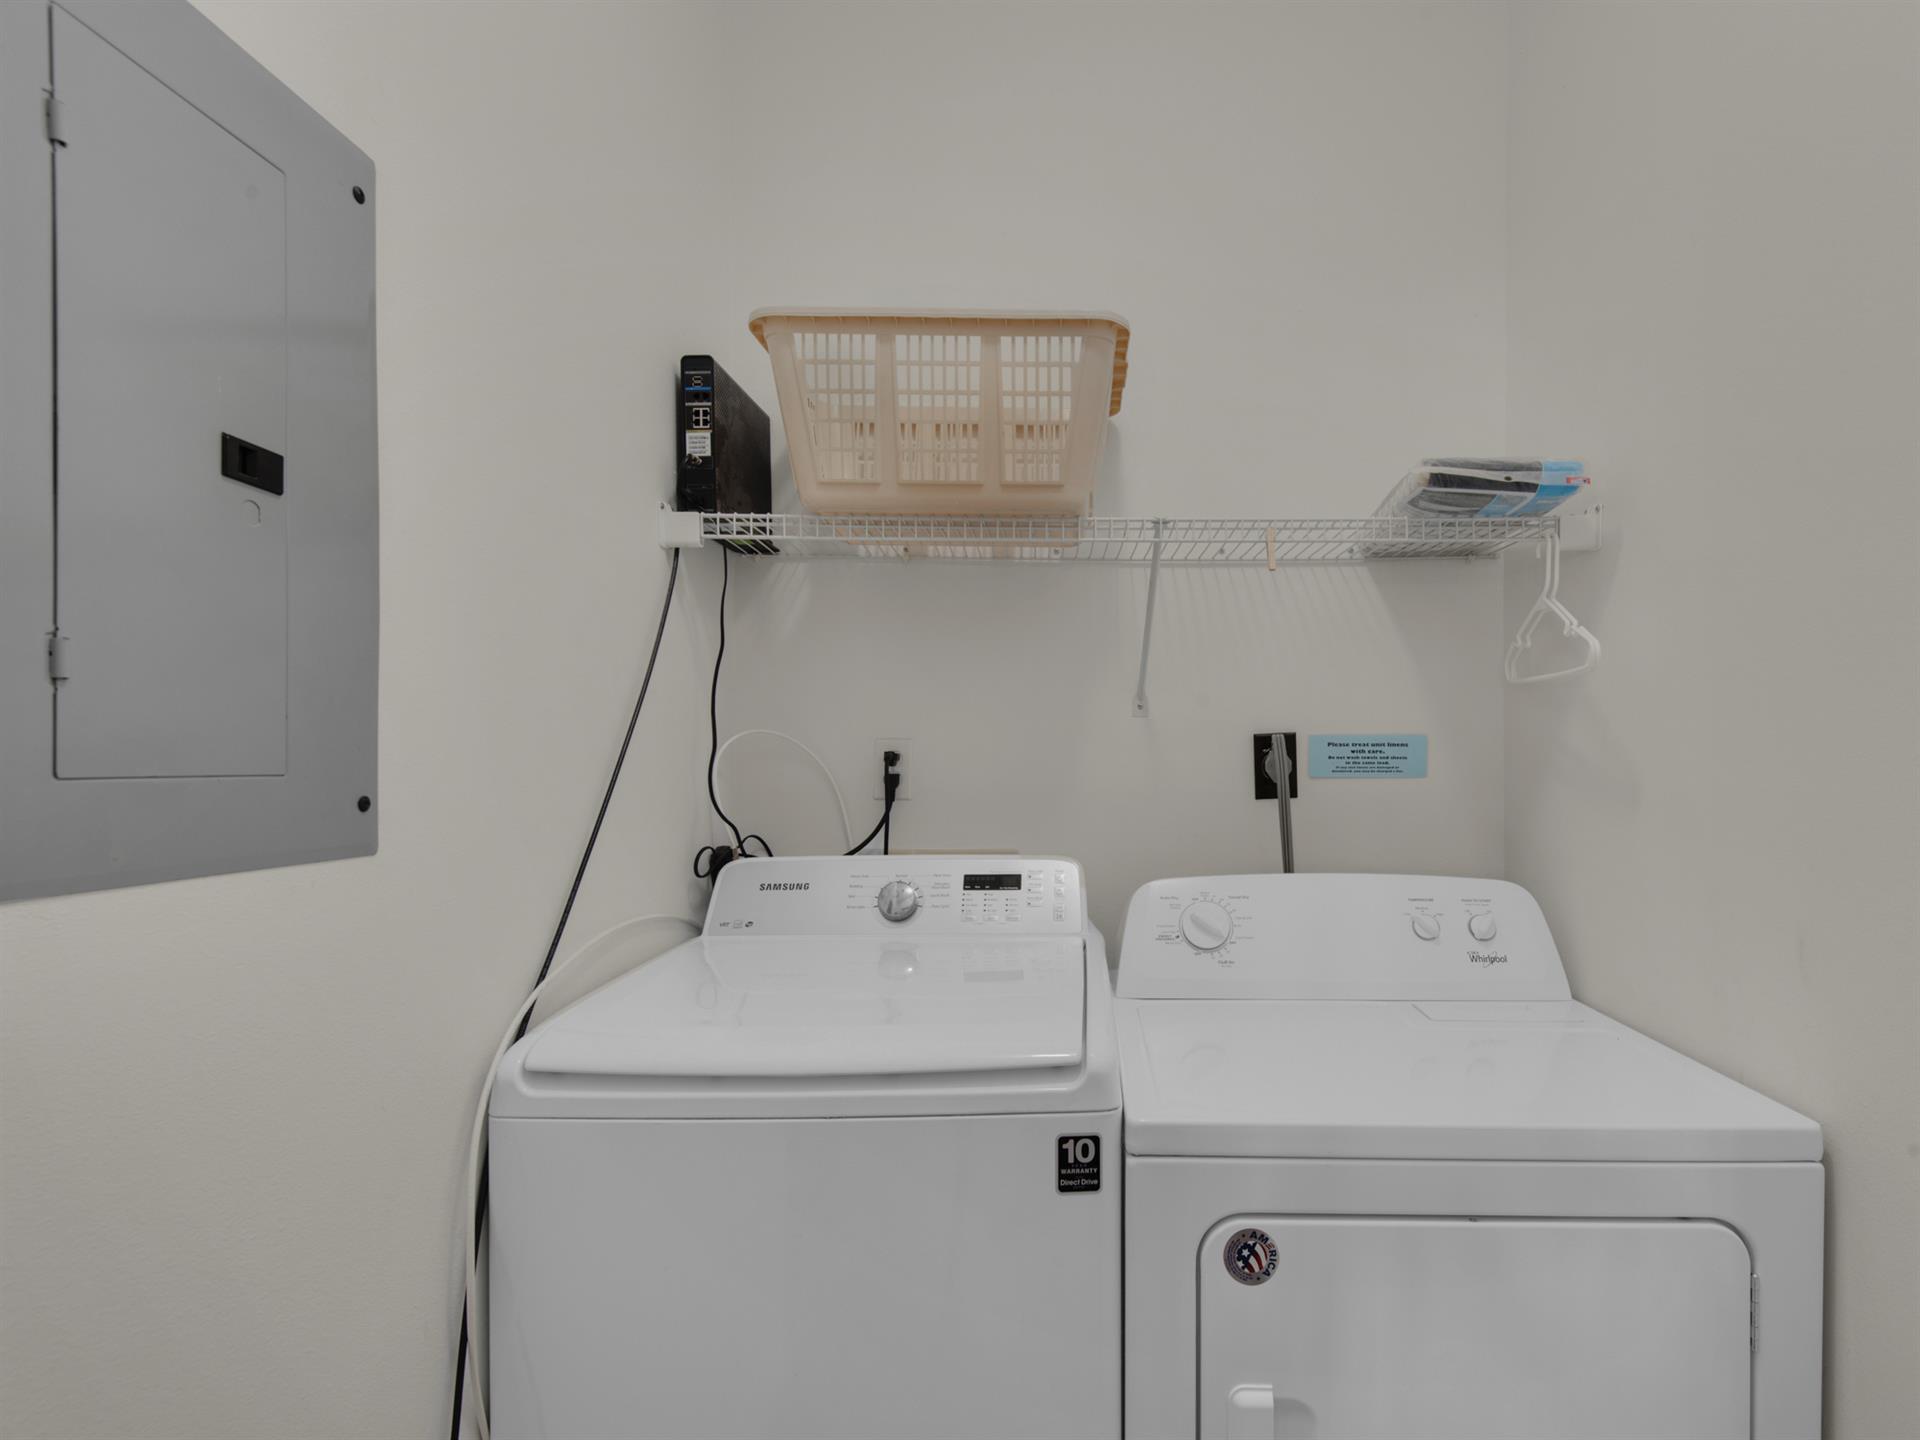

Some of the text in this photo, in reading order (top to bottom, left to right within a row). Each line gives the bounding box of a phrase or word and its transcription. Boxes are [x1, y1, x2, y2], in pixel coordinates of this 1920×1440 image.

[759, 883, 810, 891] SAMSUNG
[1469, 954, 1508, 965] Whirlpool
[1062, 1138, 1096, 1164] 10
[1060, 1178, 1080, 1186] Direct
[1249, 1231, 1277, 1277] AMERICA
